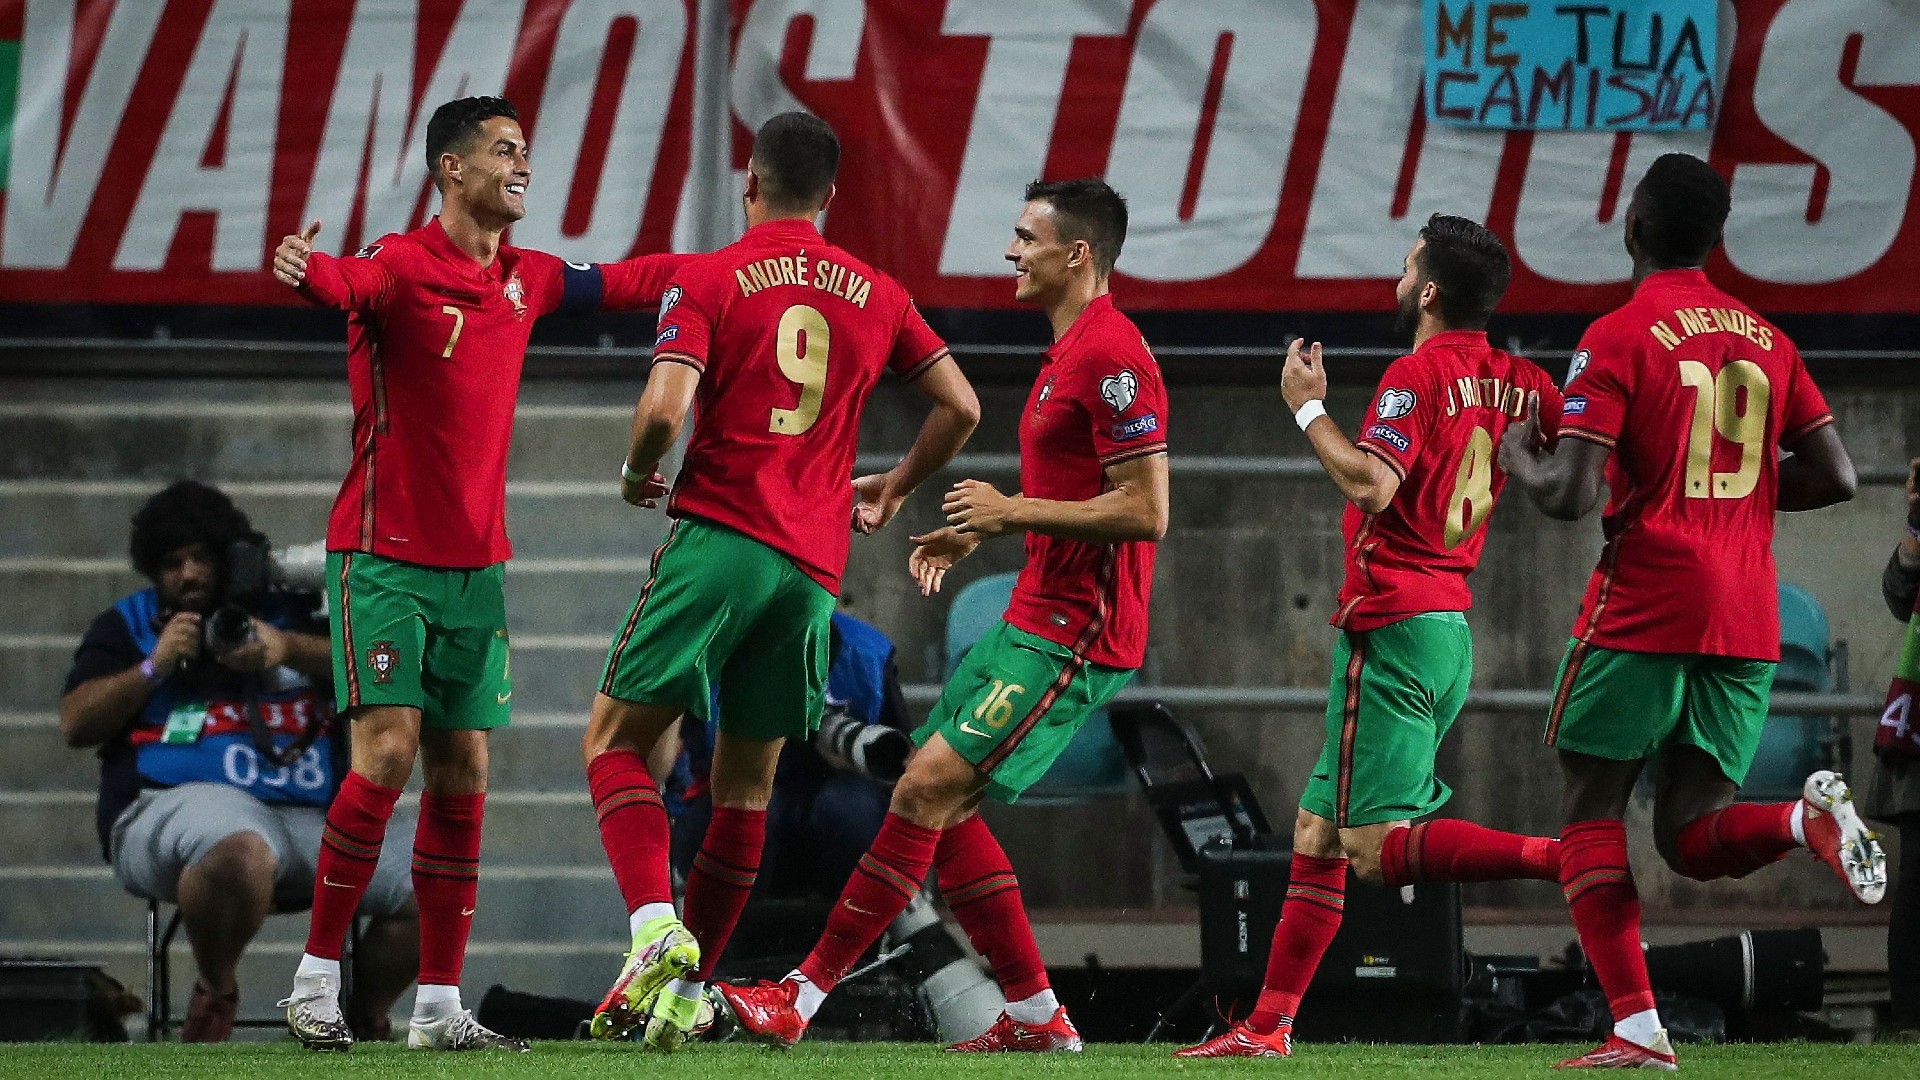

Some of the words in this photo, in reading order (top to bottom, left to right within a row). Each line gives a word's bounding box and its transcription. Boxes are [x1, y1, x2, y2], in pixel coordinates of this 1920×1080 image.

[1435, 1, 1529, 67] ME
[1555, 5, 1706, 75] TUA
[1435, 58, 1716, 127] CAMISOLA
[1, 0, 868, 272] VAMOS
[735, 248, 809, 297] ANDRÉ
[813, 260, 872, 309] SILVA
[442, 305, 464, 358] 7
[768, 304, 830, 436] 9
[1678, 359, 1771, 499] 19
[974, 679, 1026, 729] 16
[1880, 693, 1920, 746] 4
